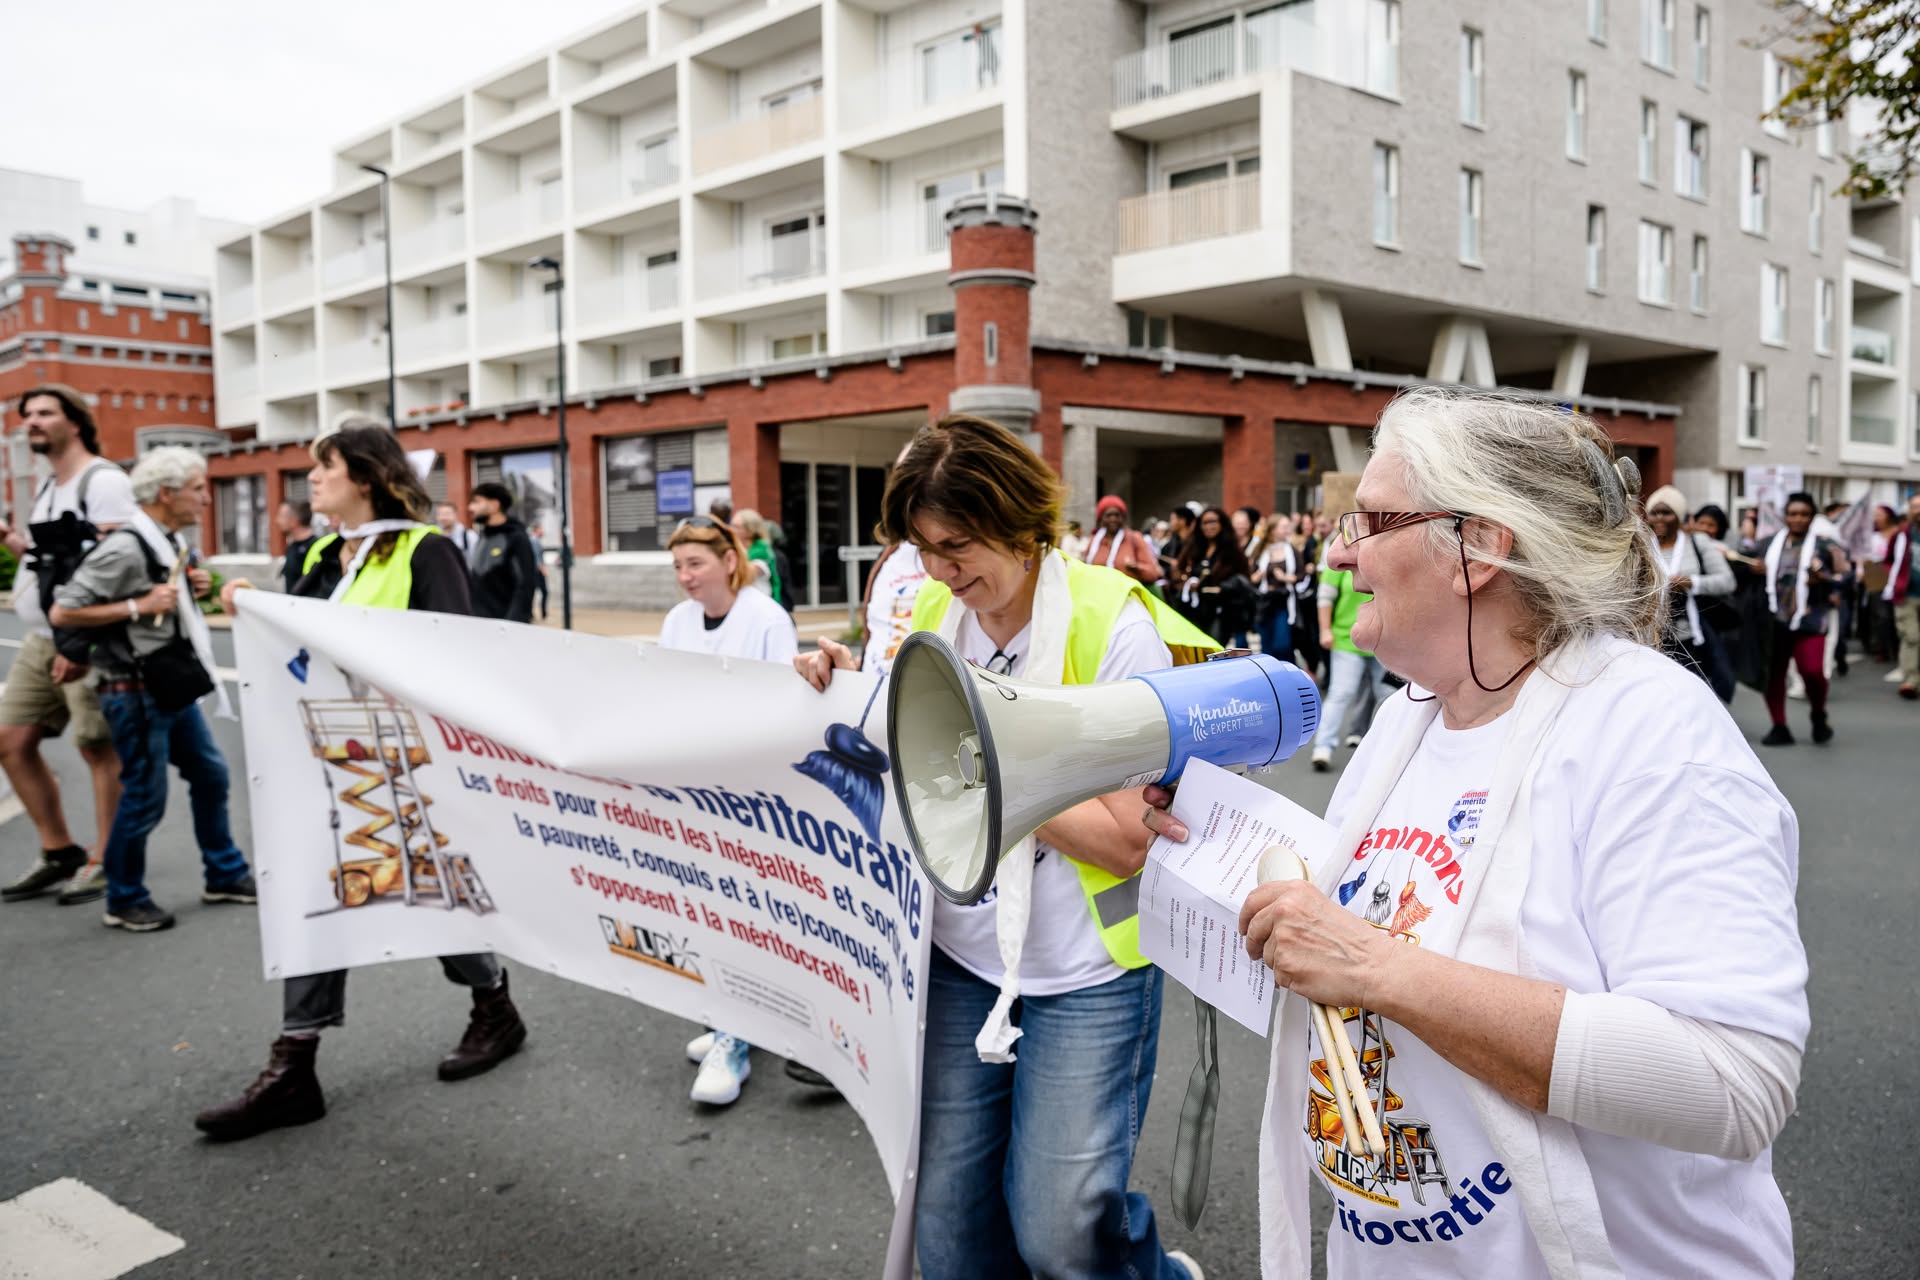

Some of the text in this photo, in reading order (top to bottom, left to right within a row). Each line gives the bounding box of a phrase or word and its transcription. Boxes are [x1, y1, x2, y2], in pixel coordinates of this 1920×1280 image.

[1188, 697, 1261, 727] Manutan
[1210, 718, 1242, 735] EXPERT
[458, 766, 491, 792] Les
[495, 774, 550, 805] droits
[553, 790, 598, 816] pour
[603, 798, 676, 840] réduire
[678, 819, 712, 853] les
[714, 832, 828, 900] inégalités
[832, 884, 857, 917] et
[513, 812, 534, 837] la
[538, 822, 631, 868] pauvreté,
[633, 849, 713, 892] conquis
[719, 876, 742, 902] et
[745, 881, 761, 910] à
[570, 864, 680, 917] s'opposent
[685, 901, 698, 923] à
[701, 902, 724, 933] la
[728, 918, 860, 1003] méritocratie
[864, 984, 872, 1015] !
[1316, 1140, 1364, 1188] RWLP
[1338, 1161, 1512, 1246] itocratie
[1354, 1188, 1368, 1198] contre
[1375, 1195, 1398, 1207] Pauvreté
